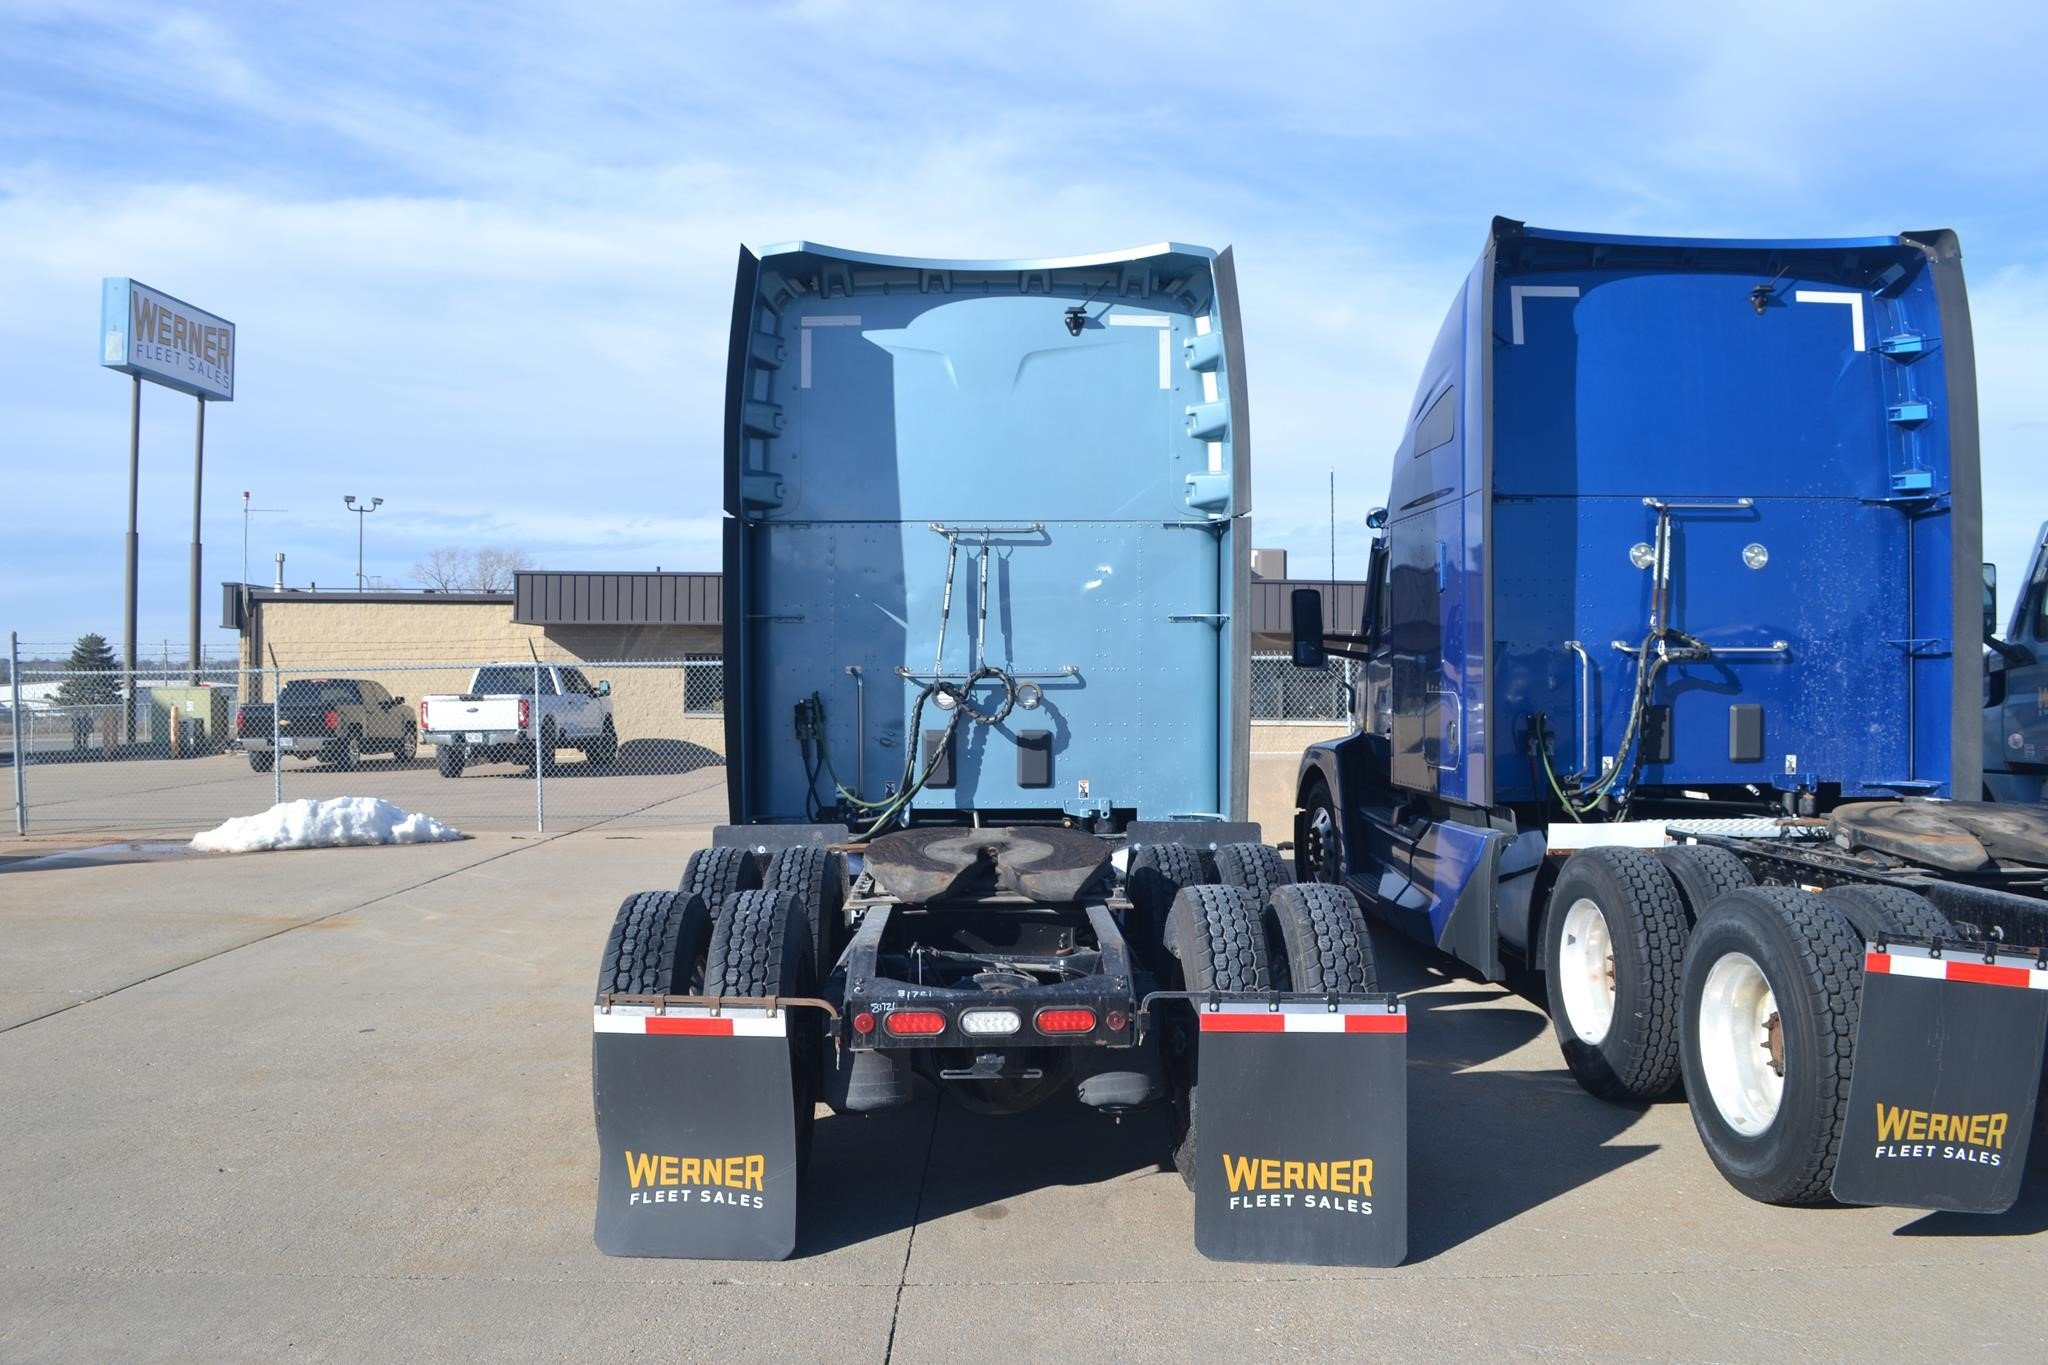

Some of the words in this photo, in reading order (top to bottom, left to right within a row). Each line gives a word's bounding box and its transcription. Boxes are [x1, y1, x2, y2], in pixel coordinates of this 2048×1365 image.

[133, 290, 231, 374] WERNER
[136, 344, 182, 366] FLEET
[188, 356, 230, 389] SALES
[1876, 1102, 2009, 1149] WERNER
[625, 1150, 765, 1192] WERNER
[1222, 1153, 1373, 1197] WERNER
[1875, 1145, 1936, 1158] FLEET
[1943, 1146, 2001, 1166] SALES
[629, 1189, 692, 1206] FLEET
[700, 1189, 764, 1209] SALES
[1229, 1194, 1295, 1210] FLEET
[1304, 1194, 1373, 1215] SALES
